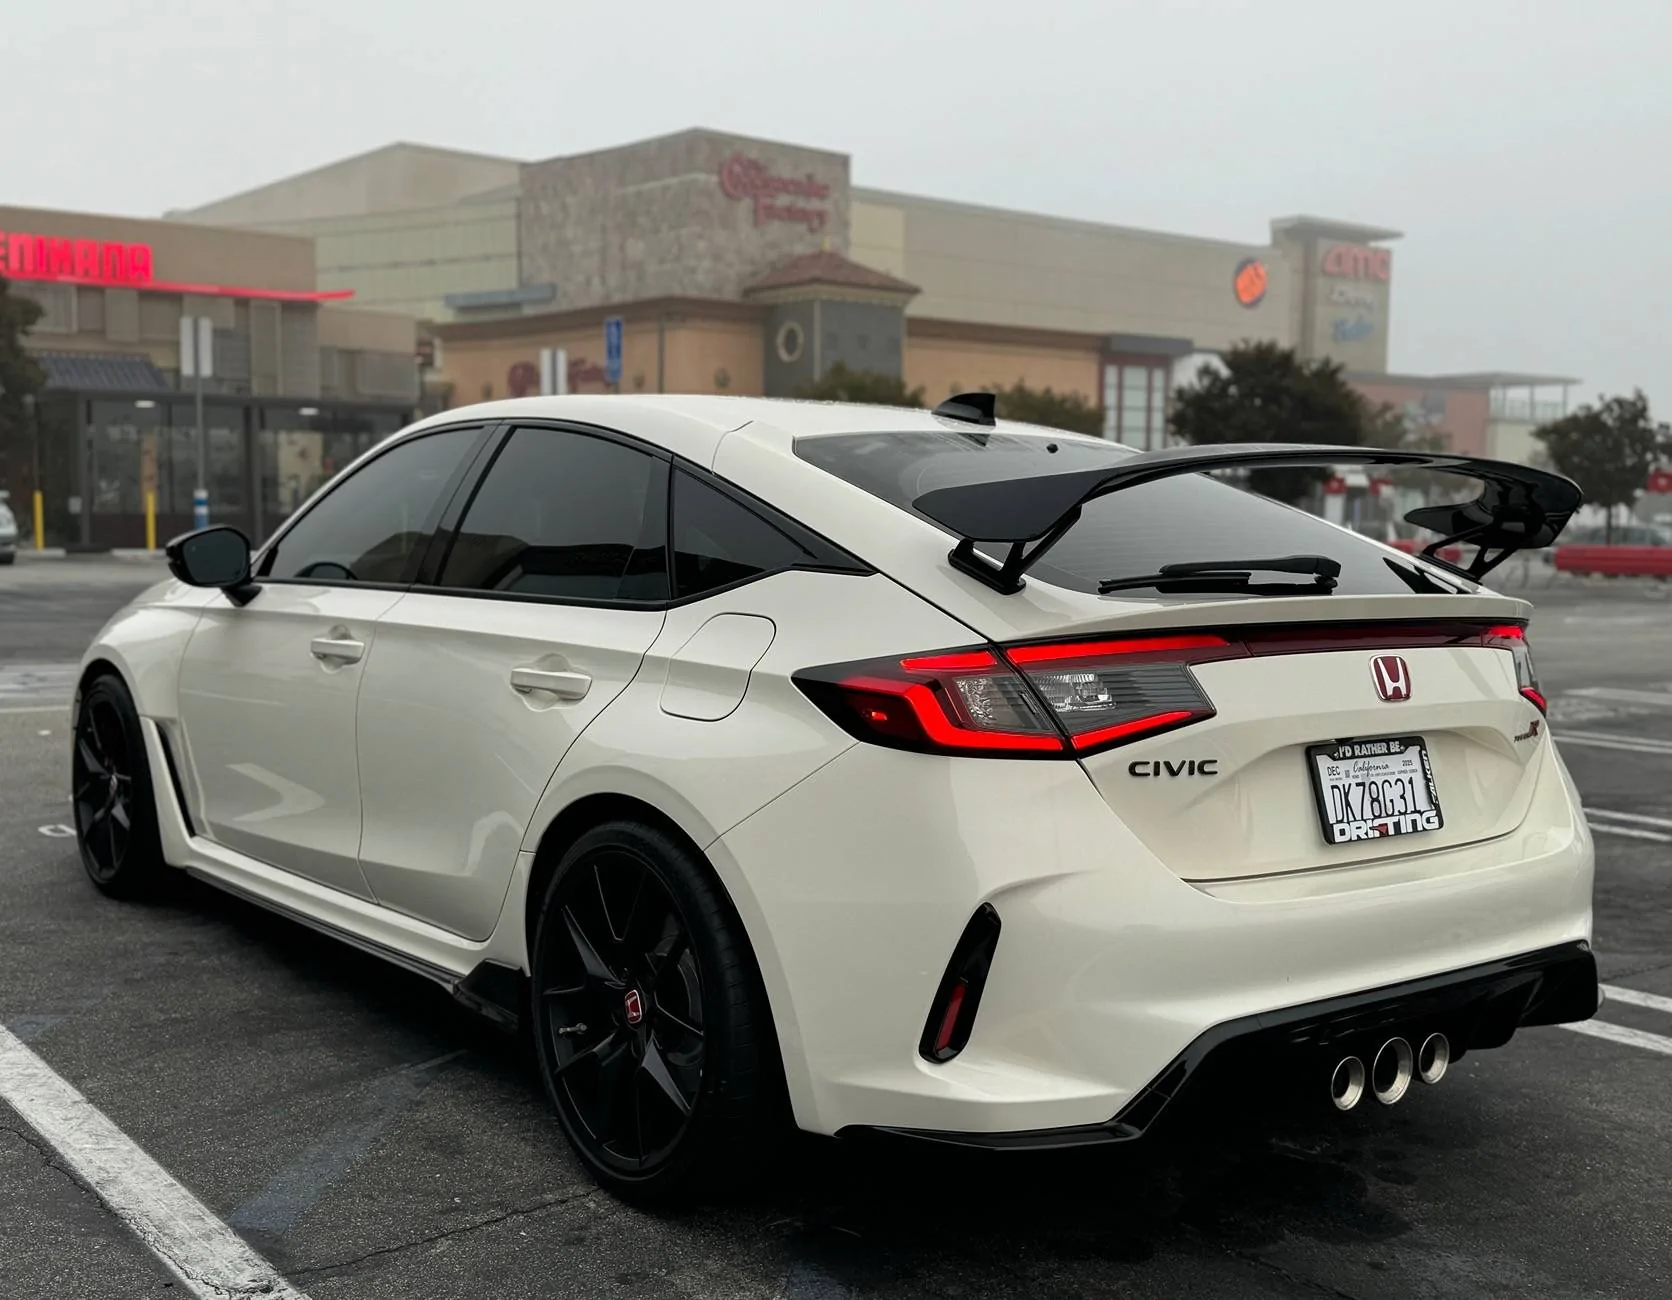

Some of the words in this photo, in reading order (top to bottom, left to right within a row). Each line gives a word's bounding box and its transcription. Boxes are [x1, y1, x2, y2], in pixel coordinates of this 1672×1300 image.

[0, 230, 153, 285] NIHANA
[1339, 745, 1352, 758] I'D
[1354, 743, 1388, 756] RATHER
[1389, 741, 1400, 753] BE
[1128, 760, 1218, 777] CIVIC
[1327, 766, 1340, 776] DEC
[1353, 760, 1389, 777] California
[1330, 776, 1421, 822] DK78G31
[1333, 810, 1440, 843] DRIFTING
